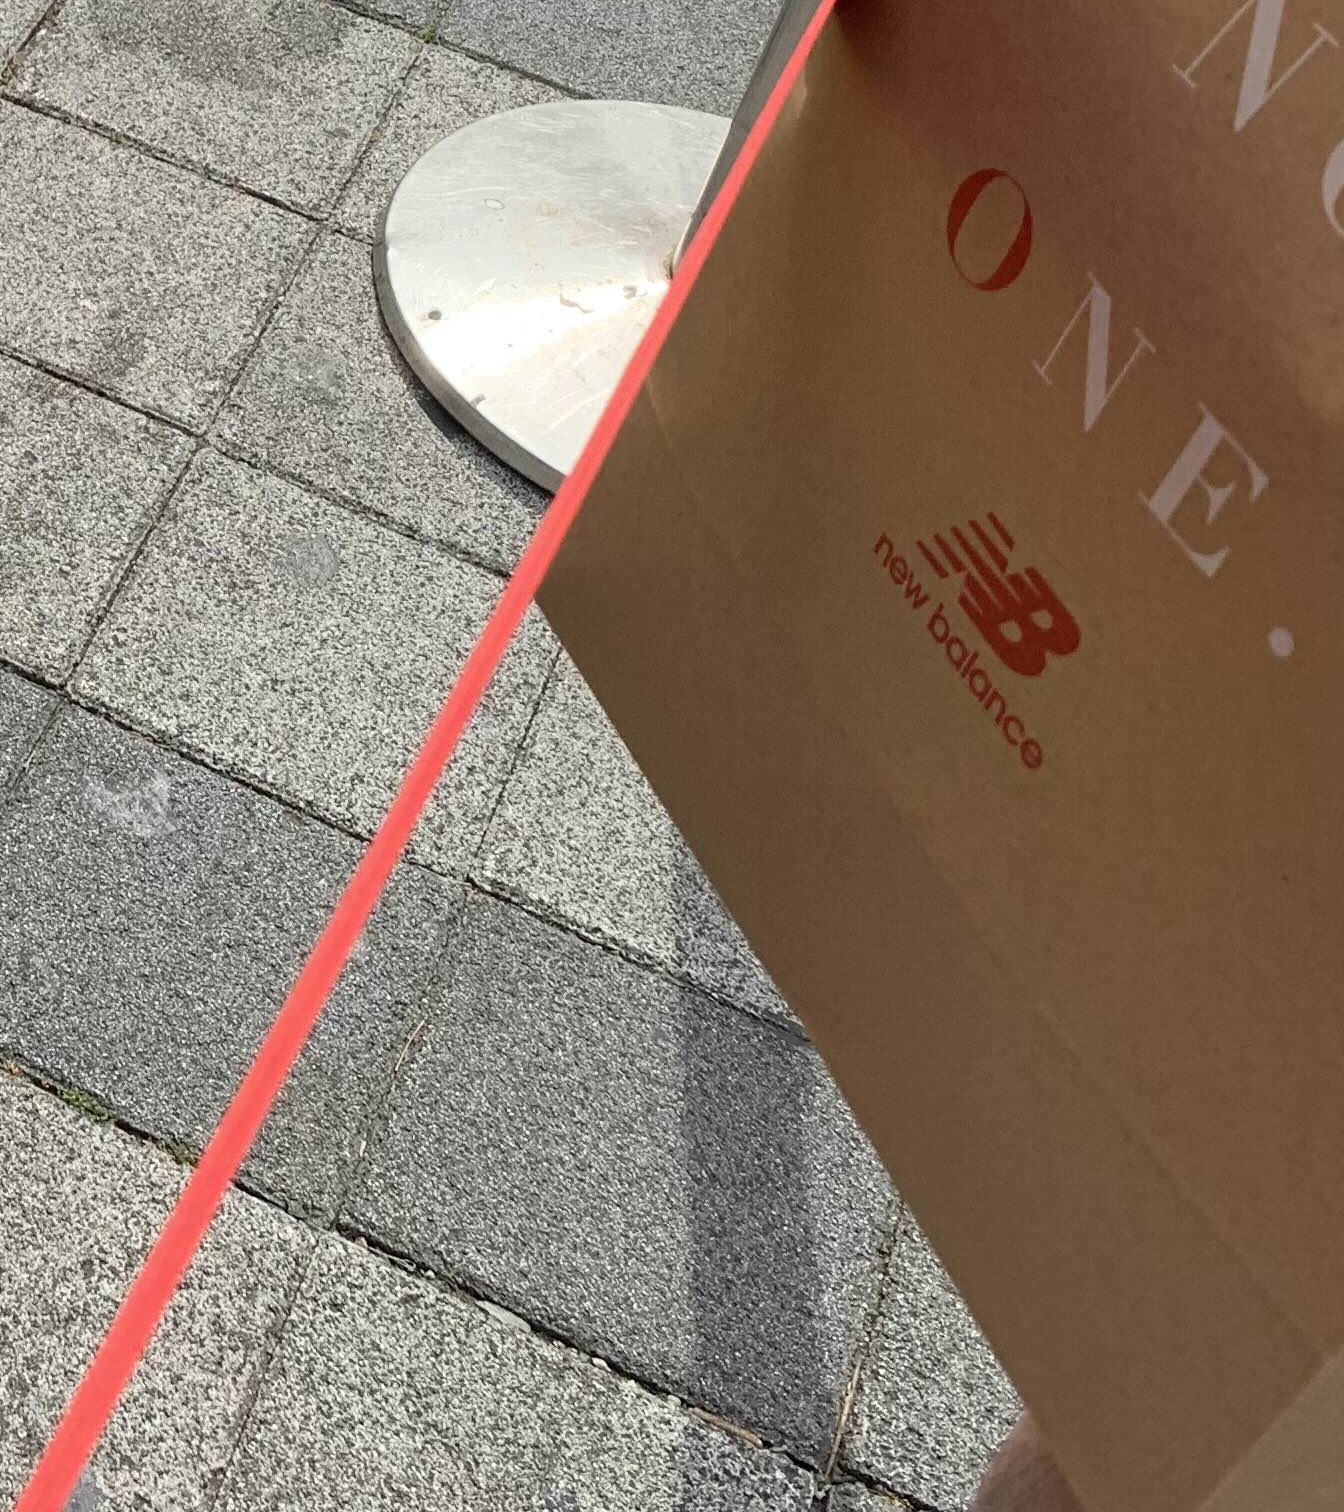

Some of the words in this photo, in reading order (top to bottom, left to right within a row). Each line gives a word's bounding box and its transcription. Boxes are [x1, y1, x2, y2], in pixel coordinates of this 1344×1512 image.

[946, 167, 1295, 658] ONE.
[873, 532, 930, 610] new
[927, 601, 1043, 769] balance
